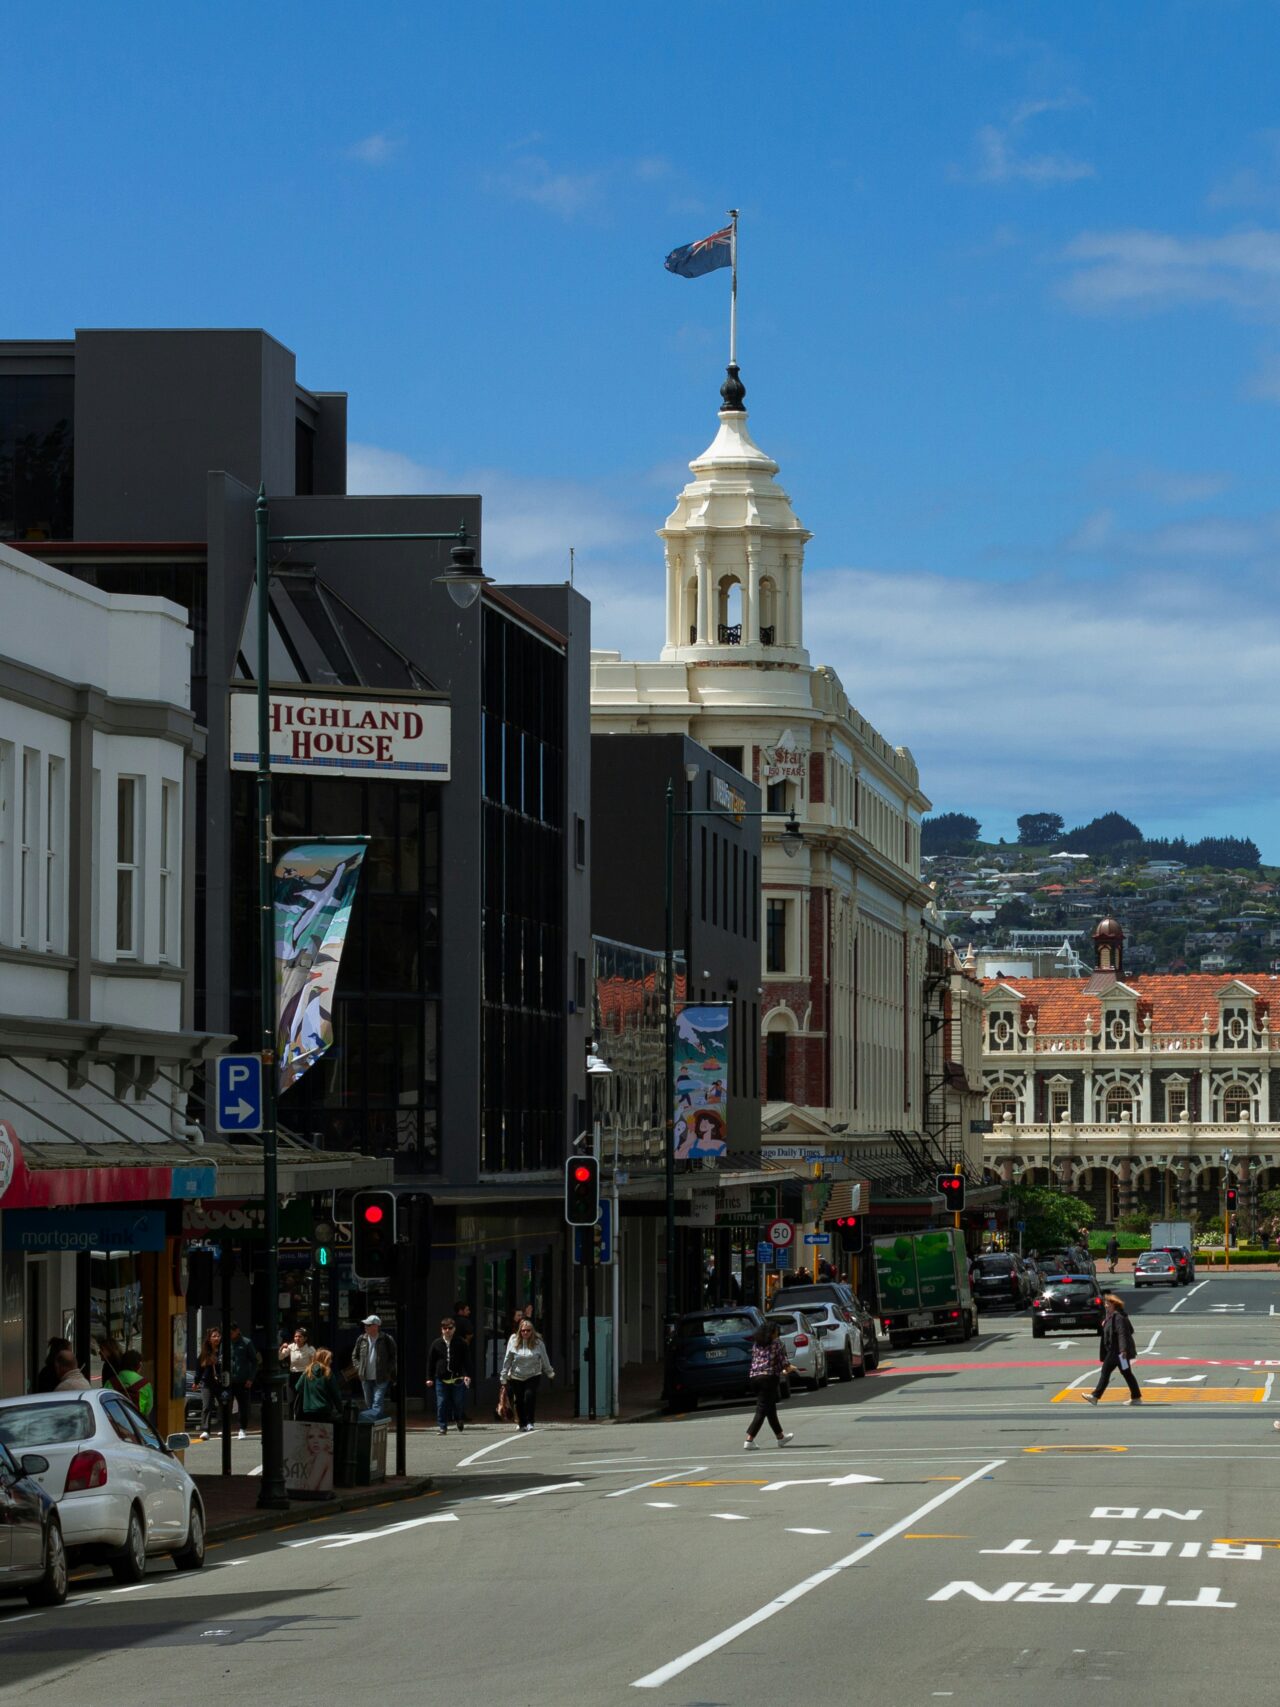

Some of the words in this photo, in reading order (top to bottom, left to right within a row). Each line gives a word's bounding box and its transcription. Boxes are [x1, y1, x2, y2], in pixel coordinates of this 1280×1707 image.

[269, 703, 424, 740] HIGHLAND
[291, 730, 394, 762] HOUSE
[782, 767, 806, 777] YEARS
[229, 1065, 250, 1091] P
[778, 1148, 796, 1158] Daily
[800, 1148, 820, 1156] Times
[21, 1232, 99, 1250] mortgage
[774, 1229, 788, 1239] 50
[284, 1459, 309, 1480] SAX
[1090, 1507, 1204, 1520] NO
[979, 1540, 1263, 1560] RIGHT
[926, 1581, 1239, 1608] TURN
